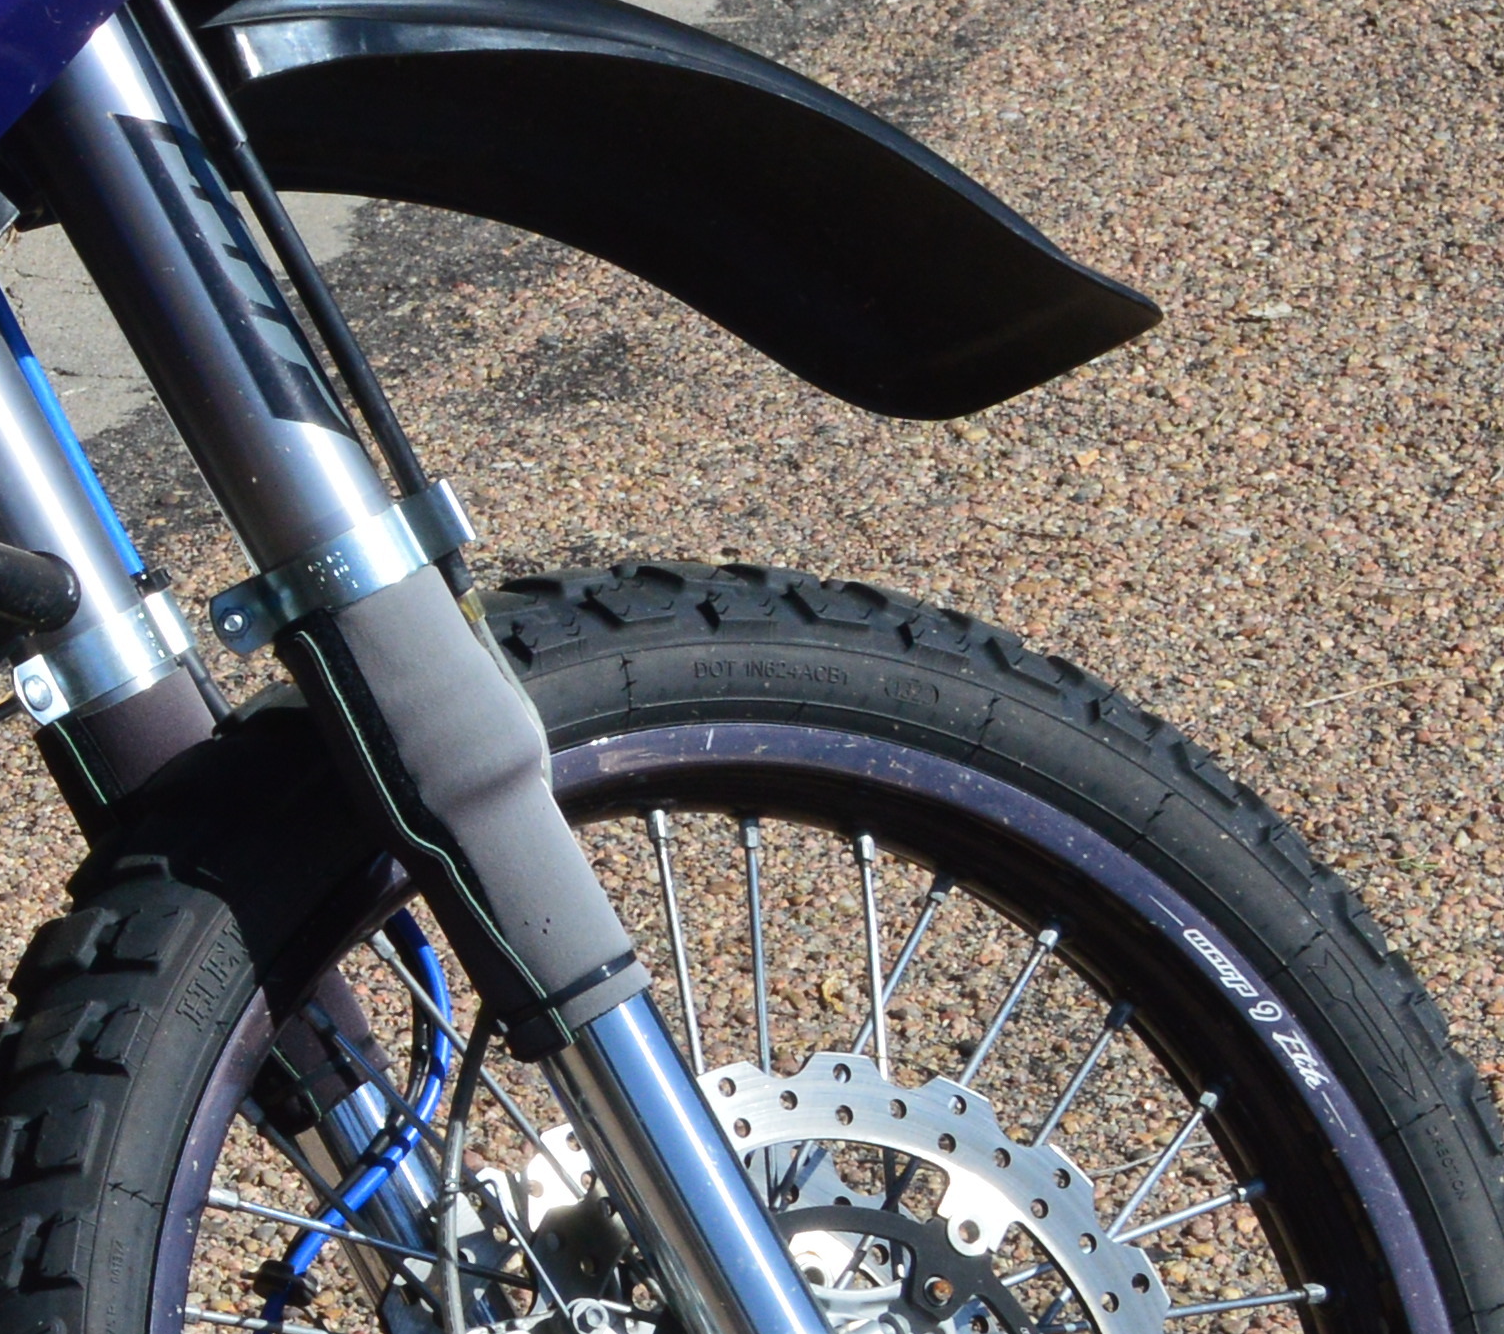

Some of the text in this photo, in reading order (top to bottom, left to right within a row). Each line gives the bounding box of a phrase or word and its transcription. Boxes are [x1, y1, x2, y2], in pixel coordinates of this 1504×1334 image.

[693, 658, 738, 679] DOT
[1249, 1000, 1282, 1022] 9
[1272, 1030, 1329, 1090] Elite
